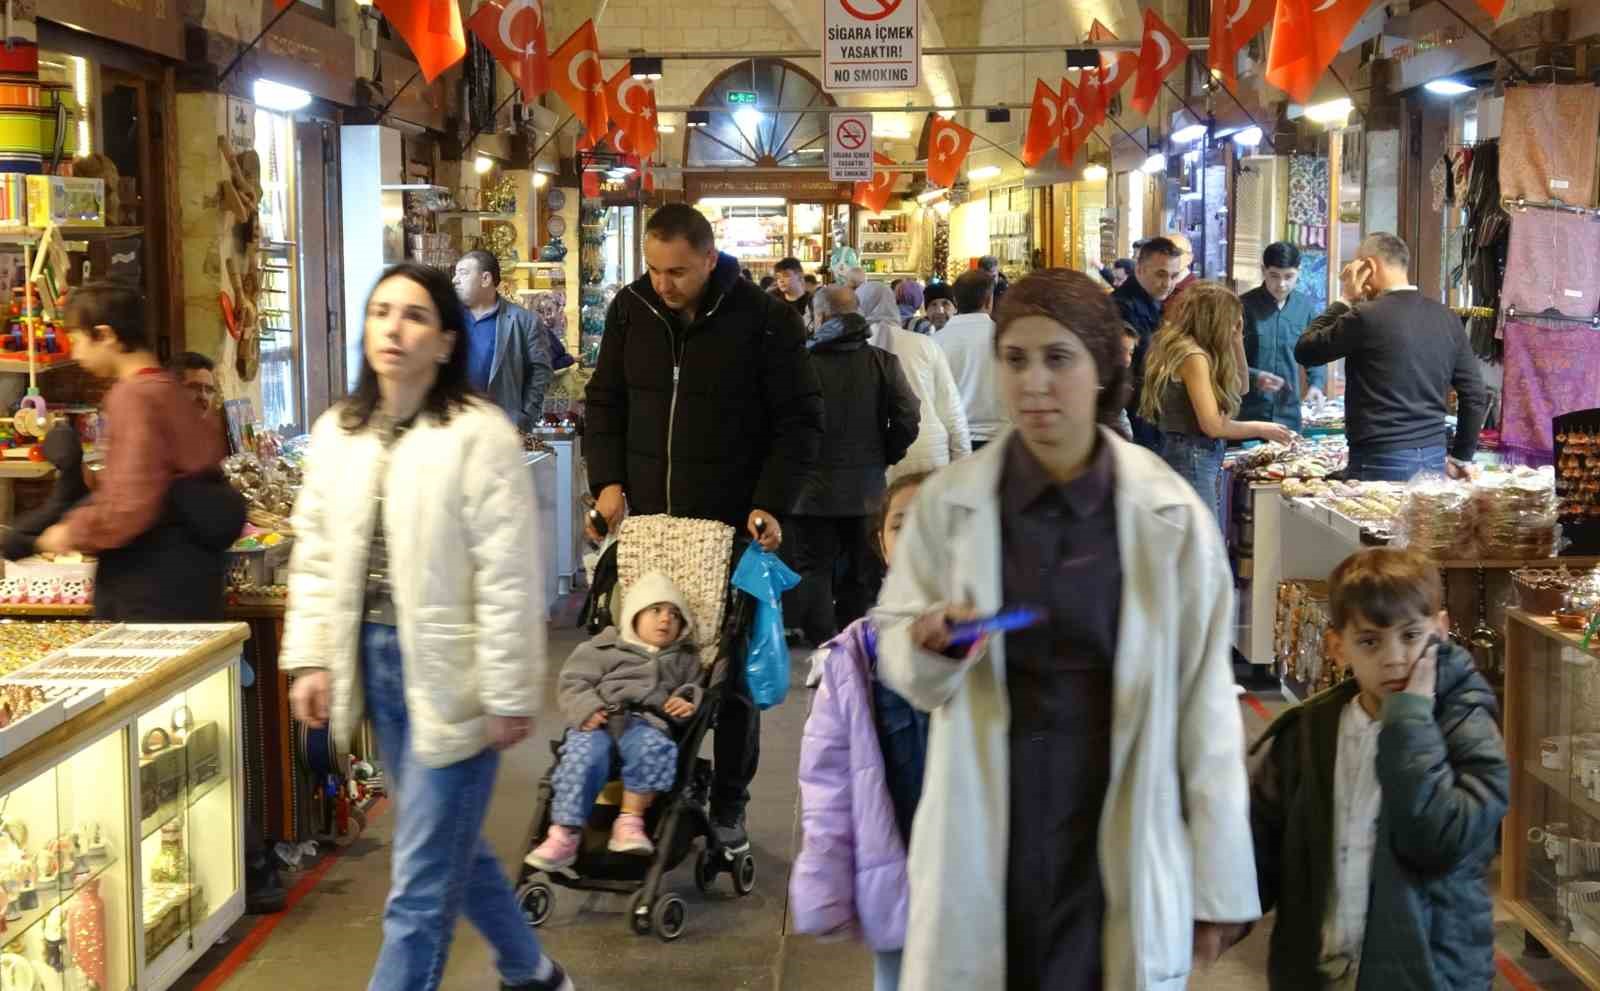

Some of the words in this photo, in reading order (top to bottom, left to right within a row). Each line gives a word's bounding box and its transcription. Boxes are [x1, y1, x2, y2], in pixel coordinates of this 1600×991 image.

[828, 24, 871, 40] SİGARA
[875, 24, 913, 42] İÇMEK
[840, 45, 903, 58] YASAKTIR!
[834, 69, 850, 82] NO
[854, 68, 908, 81] SMOKING
